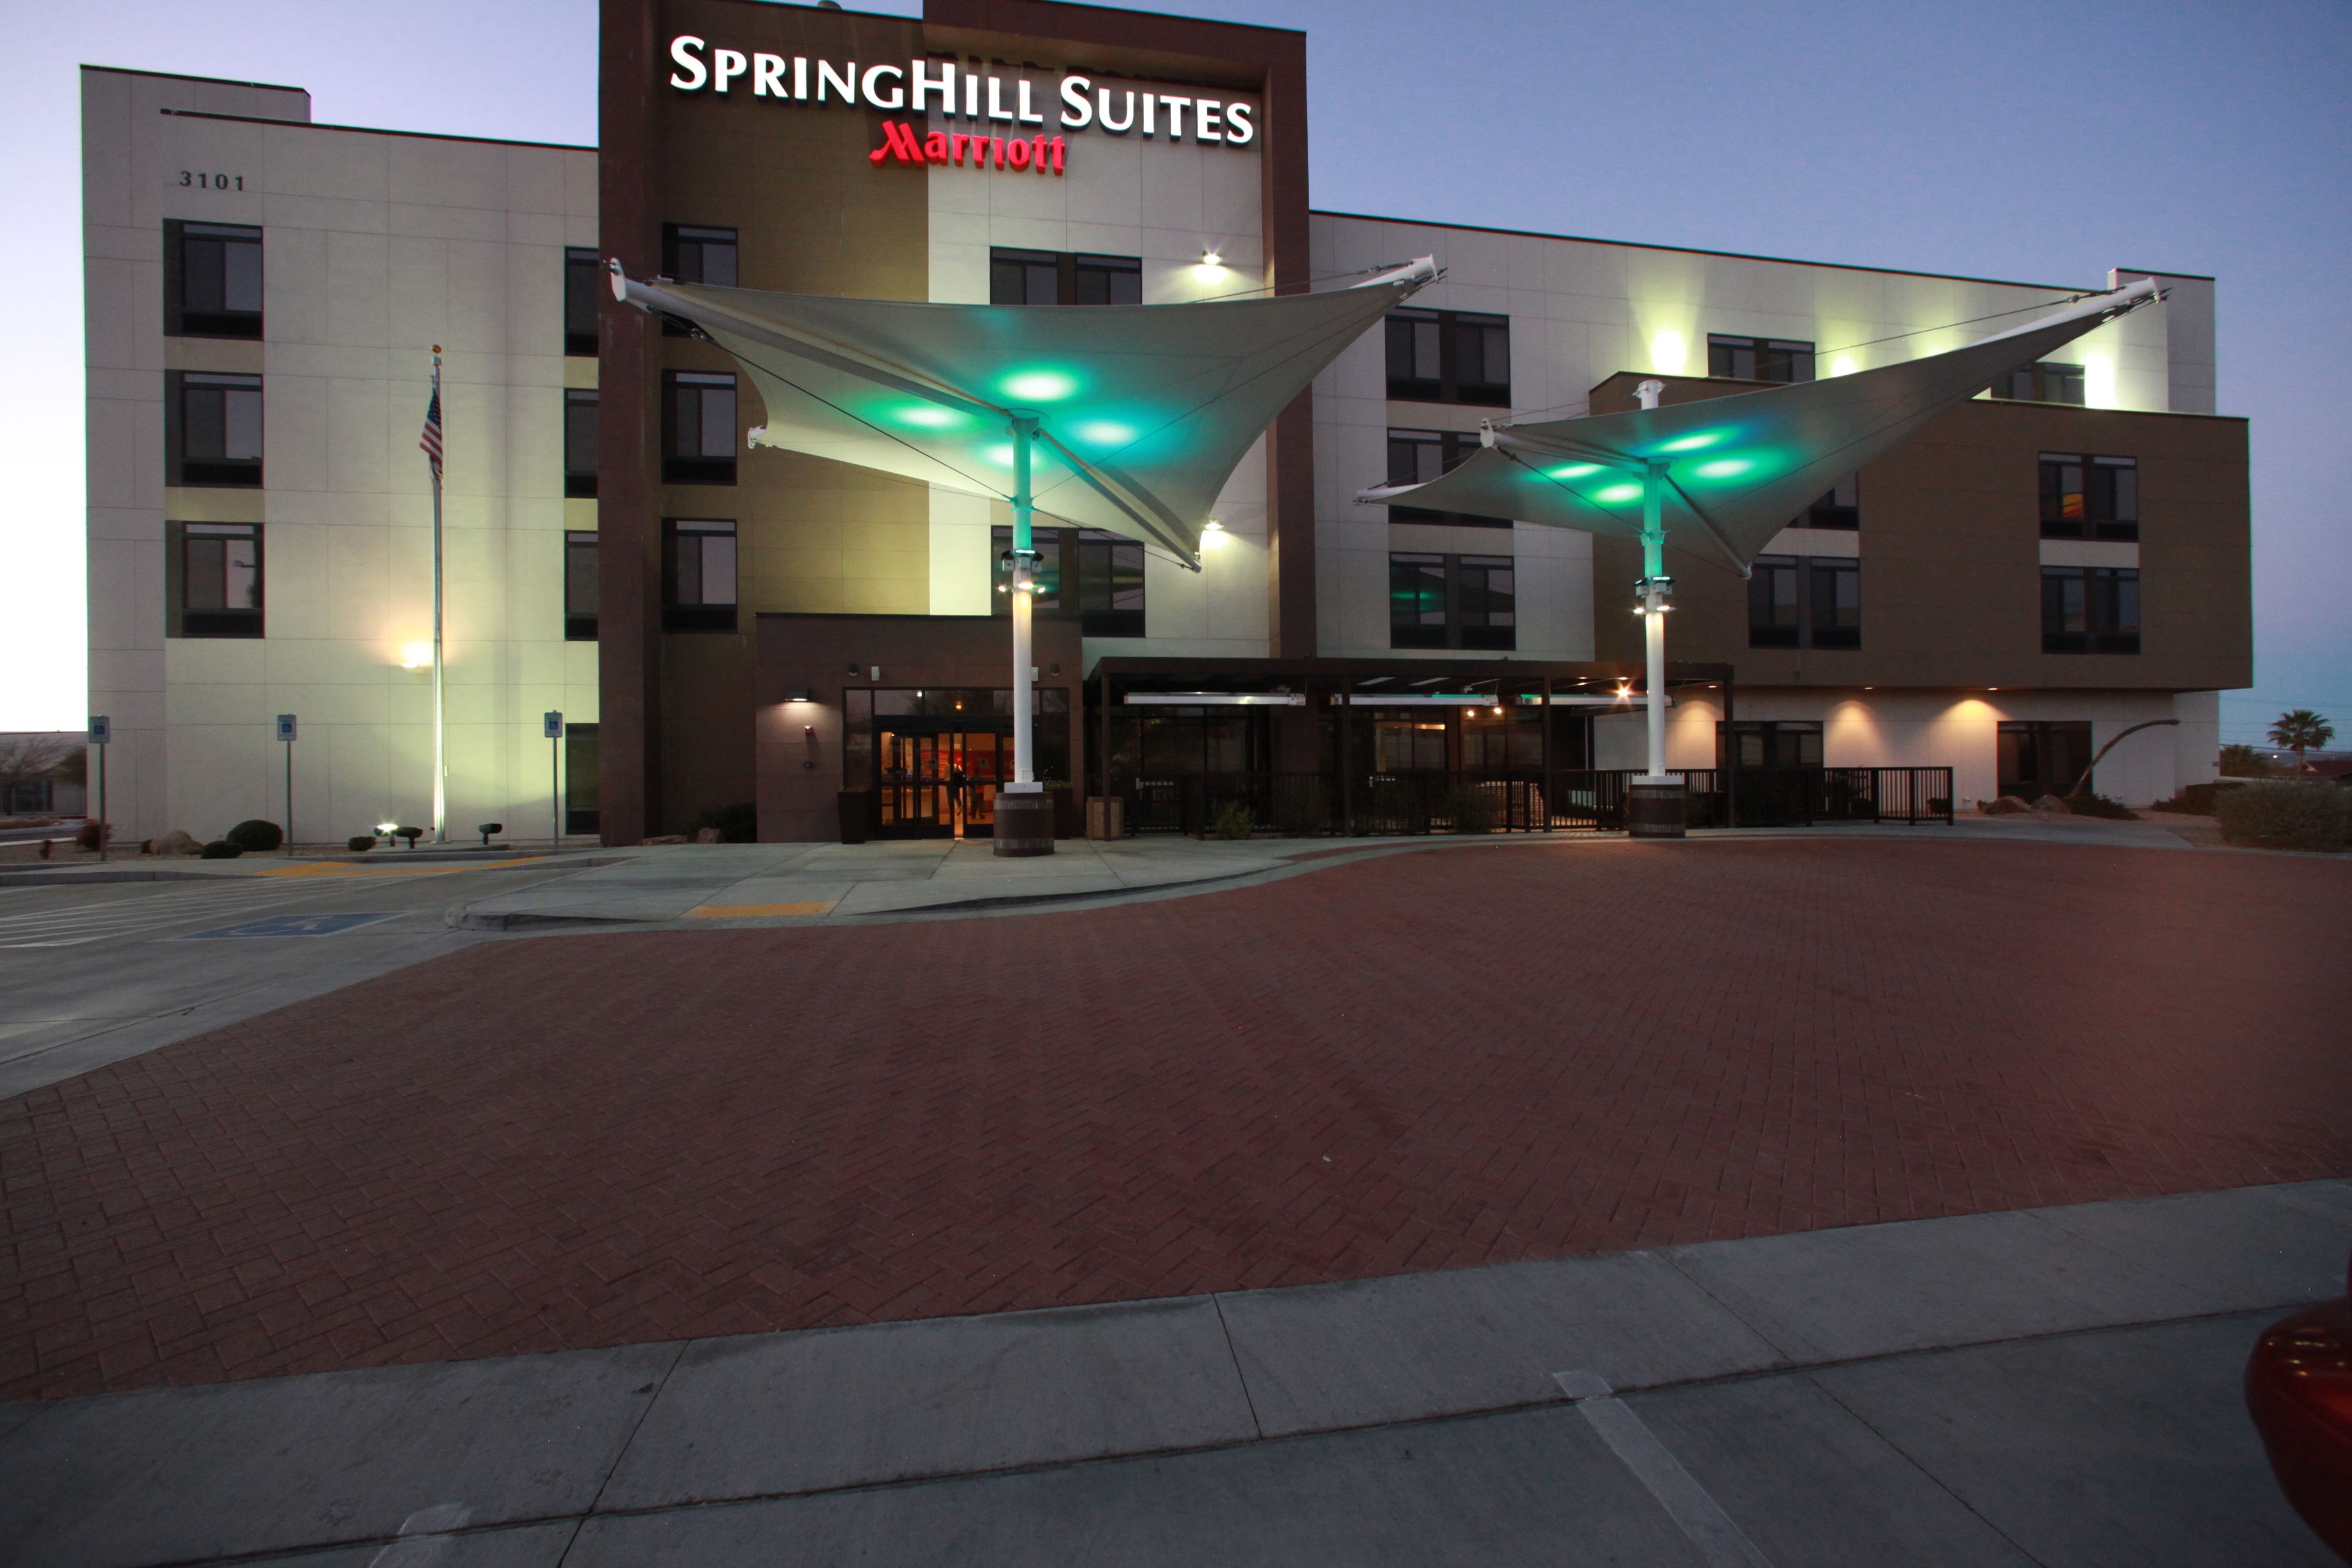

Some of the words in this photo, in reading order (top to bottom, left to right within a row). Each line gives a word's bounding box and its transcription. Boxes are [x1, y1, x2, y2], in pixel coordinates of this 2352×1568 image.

[1060, 75, 1254, 145] SUITES
[869, 120, 1066, 175] Marriott
[179, 170, 243, 191] 3101
